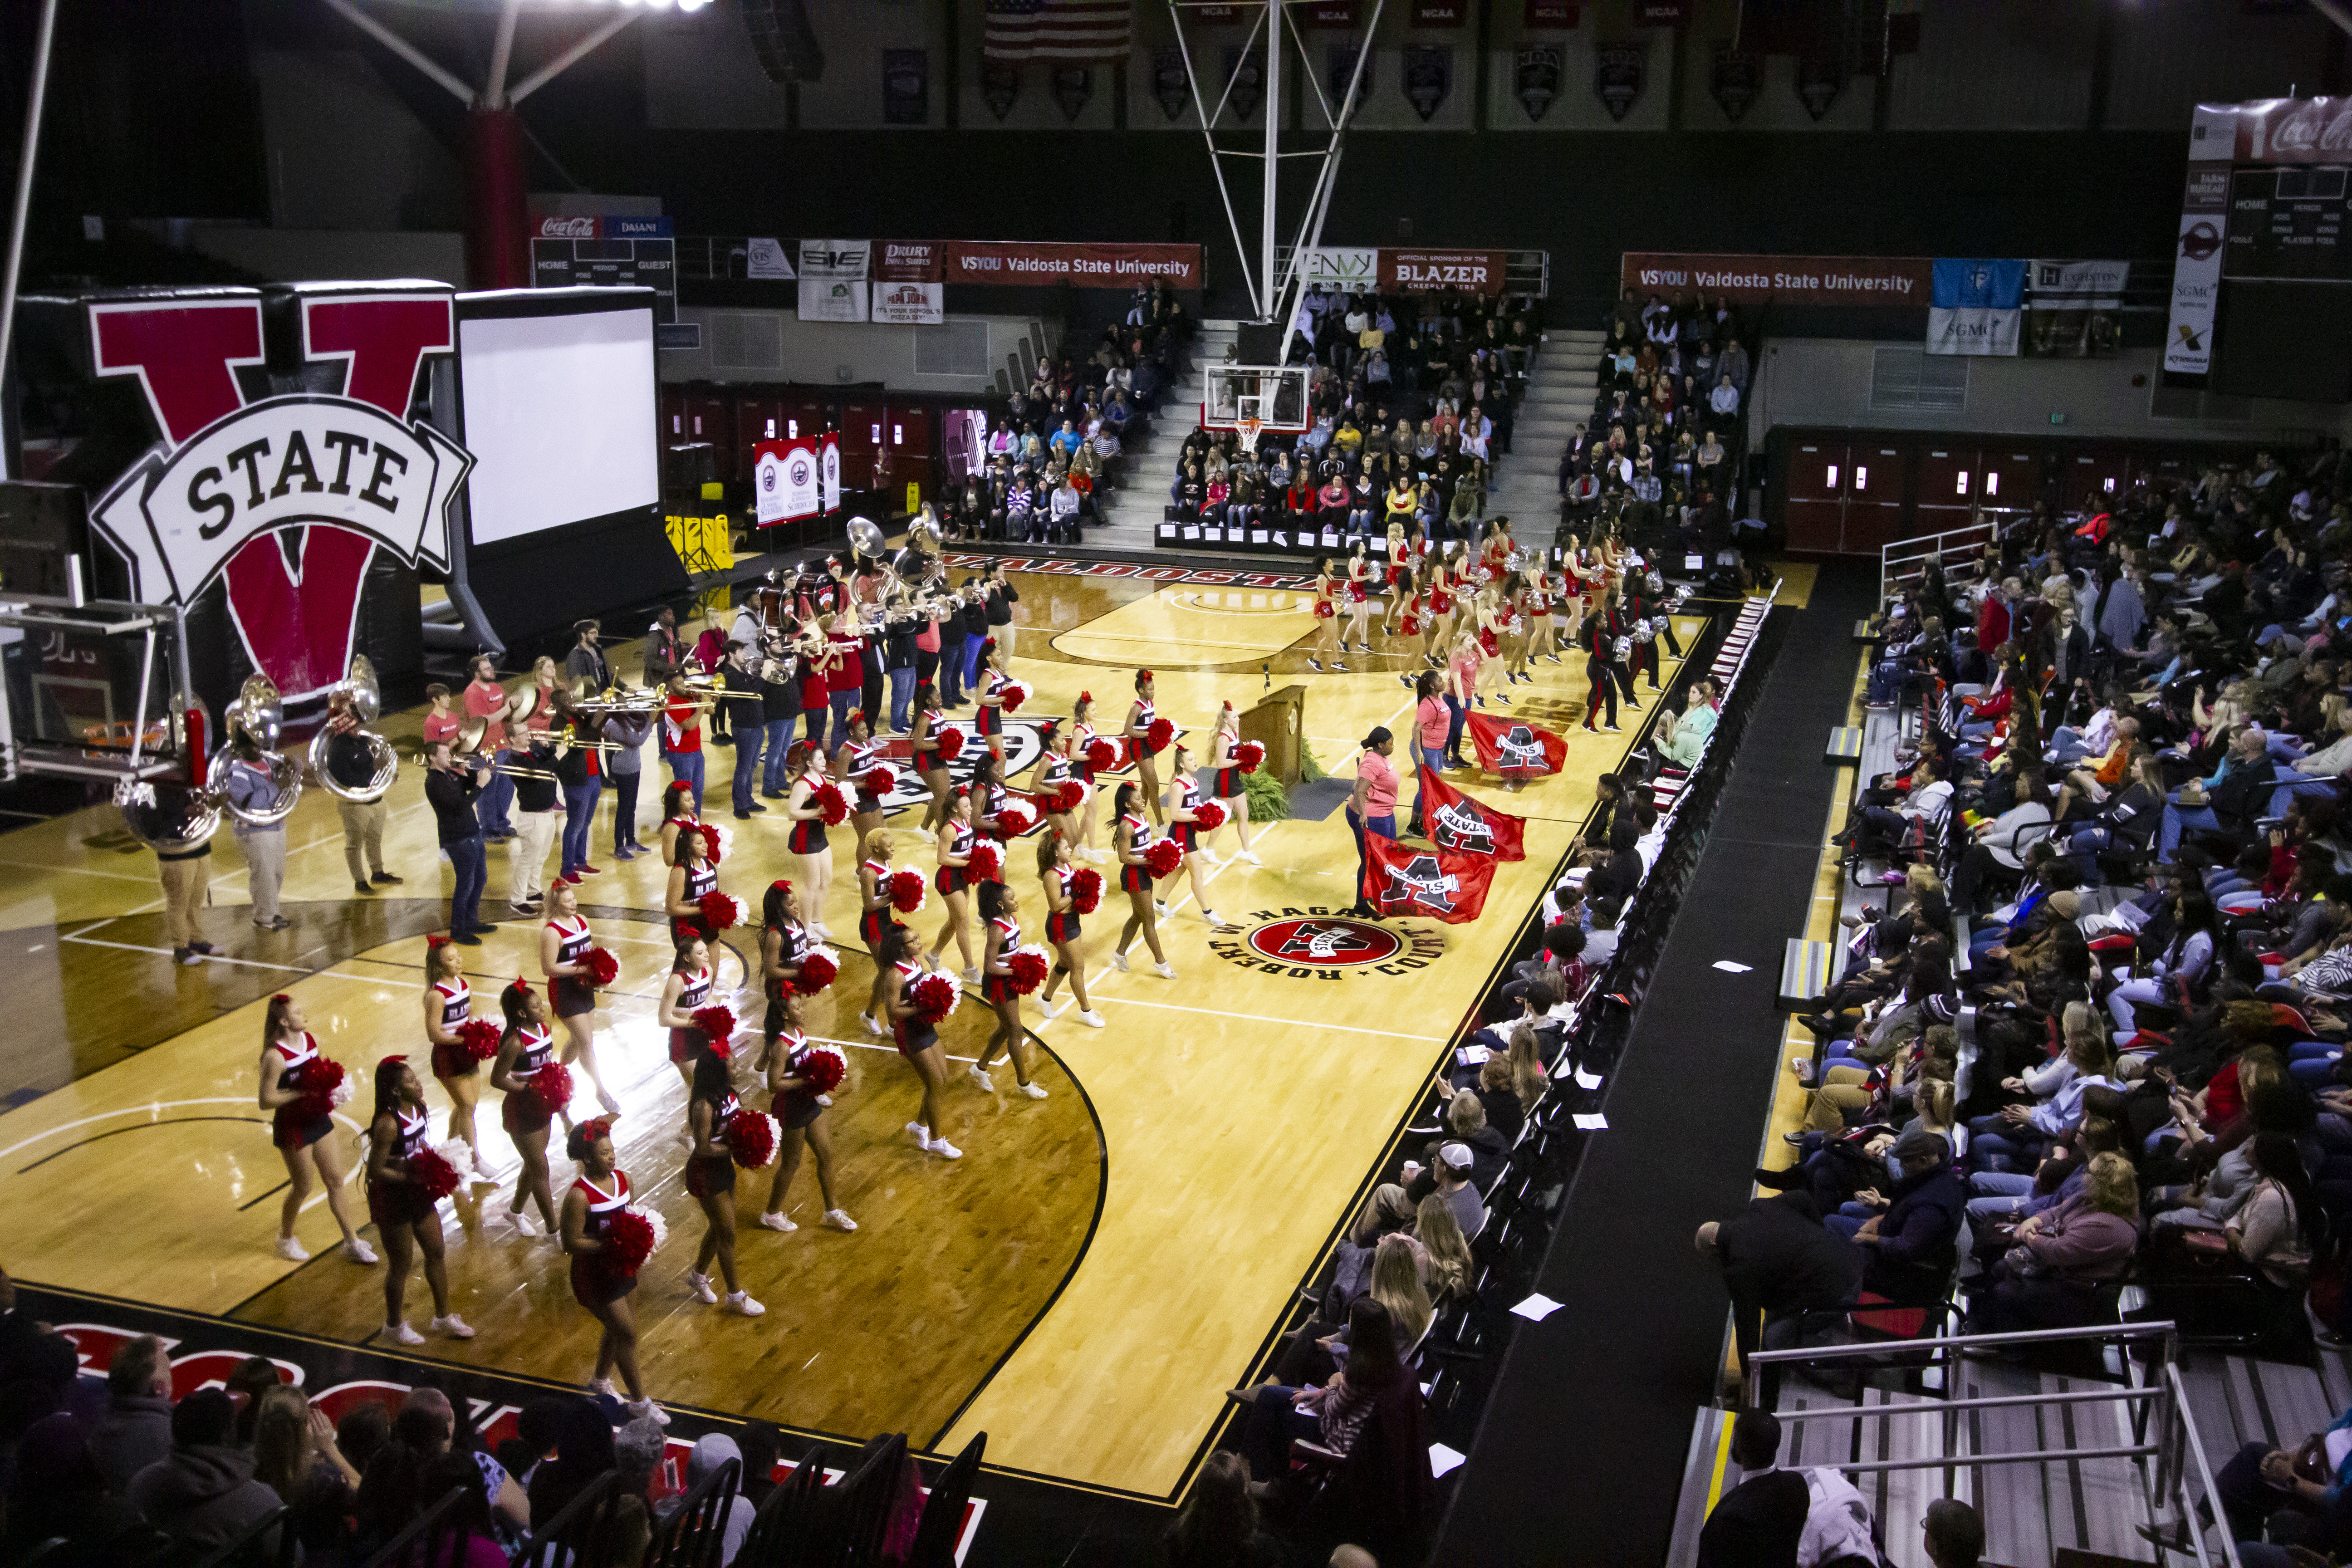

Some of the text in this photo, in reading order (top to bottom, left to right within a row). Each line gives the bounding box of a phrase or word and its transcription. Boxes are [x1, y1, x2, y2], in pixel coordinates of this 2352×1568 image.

[1201, 8, 1232, 16] NCAA
[1318, 11, 1349, 20] NCAA
[1421, 8, 1455, 18] NCAA
[1535, 9, 1567, 18] NCAA
[1645, 7, 1679, 17] NCAA
[2189, 184, 2224, 194] BUREAU
[2235, 200, 2268, 210] HOME
[621, 222, 657, 233] DASANI
[2283, 236, 2336, 245] PLAYER FOUL
[538, 261, 568, 270] HOME
[637, 261, 671, 270] GUEST
[961, 256, 1190, 277] VSYOU Valdosta State University
[1396, 265, 1487, 283] BLAZER
[1640, 270, 1913, 294] VSYOU Valdosta State University
[2176, 285, 2212, 297] SGMC
[887, 293, 904, 304] PAPA
[188, 430, 407, 540] STATE
[788, 500, 815, 511] SCIENCES
[943, 554, 1352, 592] VALDOSTA
[1443, 812, 1487, 833] STATE
[1209, 906, 1386, 980] ROBERT W. HAGAN
[1314, 928, 1343, 951] STATE
[1374, 928, 1444, 976] COURT
